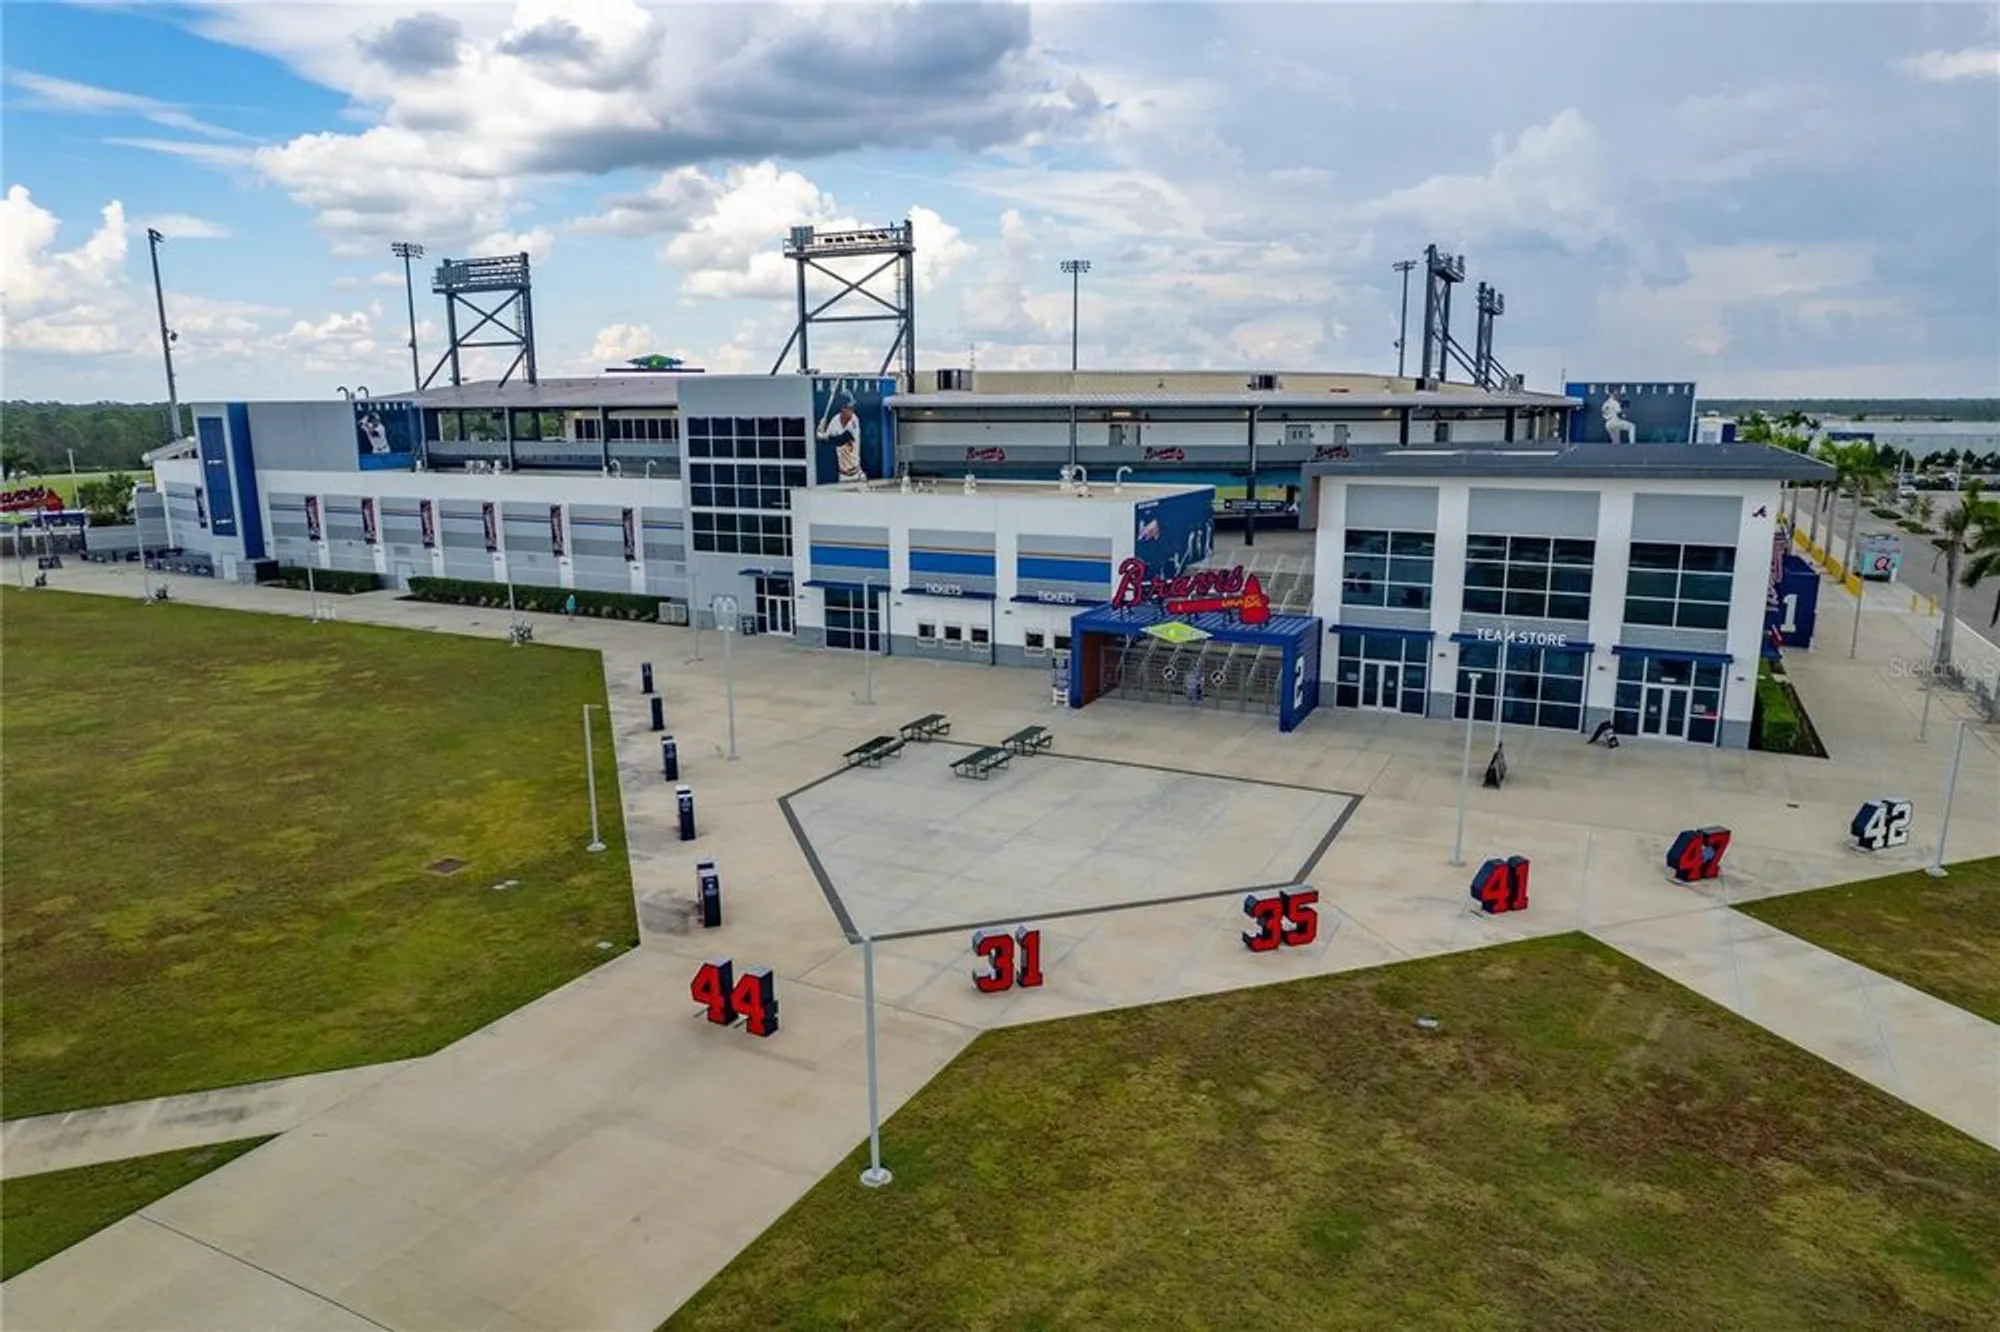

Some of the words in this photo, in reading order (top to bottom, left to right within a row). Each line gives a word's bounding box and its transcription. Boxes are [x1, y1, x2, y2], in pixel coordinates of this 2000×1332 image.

[925, 582, 962, 596] TICKETS
[1036, 590, 1076, 604] TICKETS
[1112, 557, 1244, 611] Braves
[1518, 630, 1567, 648] STORE
[1780, 593, 1798, 633] 1
[1293, 656, 1305, 710] 2
[1859, 800, 1912, 851] 42
[1673, 828, 1731, 882] 47
[1475, 858, 1530, 915] 41
[1245, 889, 1319, 952] 35
[974, 929, 1043, 993] 31
[690, 961, 771, 1037] 44
